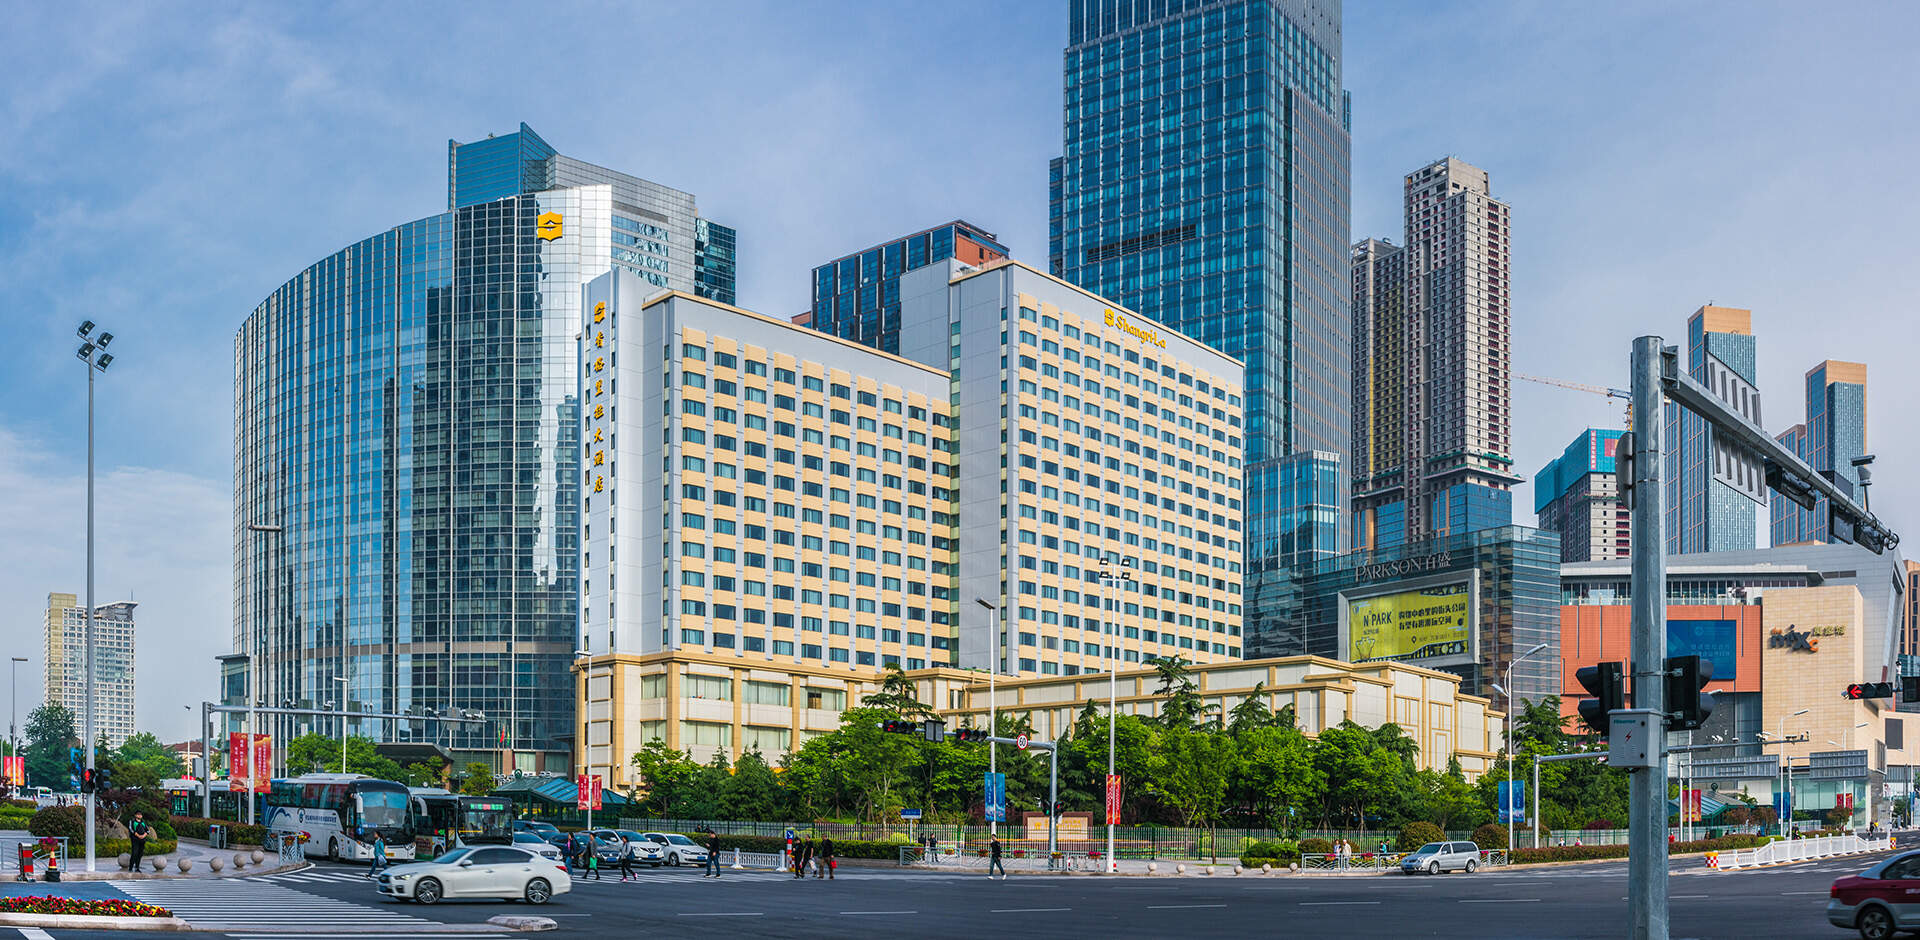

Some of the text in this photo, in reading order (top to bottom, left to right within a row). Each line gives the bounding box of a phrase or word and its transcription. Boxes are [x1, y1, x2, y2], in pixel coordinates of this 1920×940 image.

[1115, 315, 1167, 349] Shangri-La
[594, 331, 604, 494] 香格里拉大酒店
[1355, 558, 1422, 582] PARKSON
[1019, 737, 1026, 746] 60
